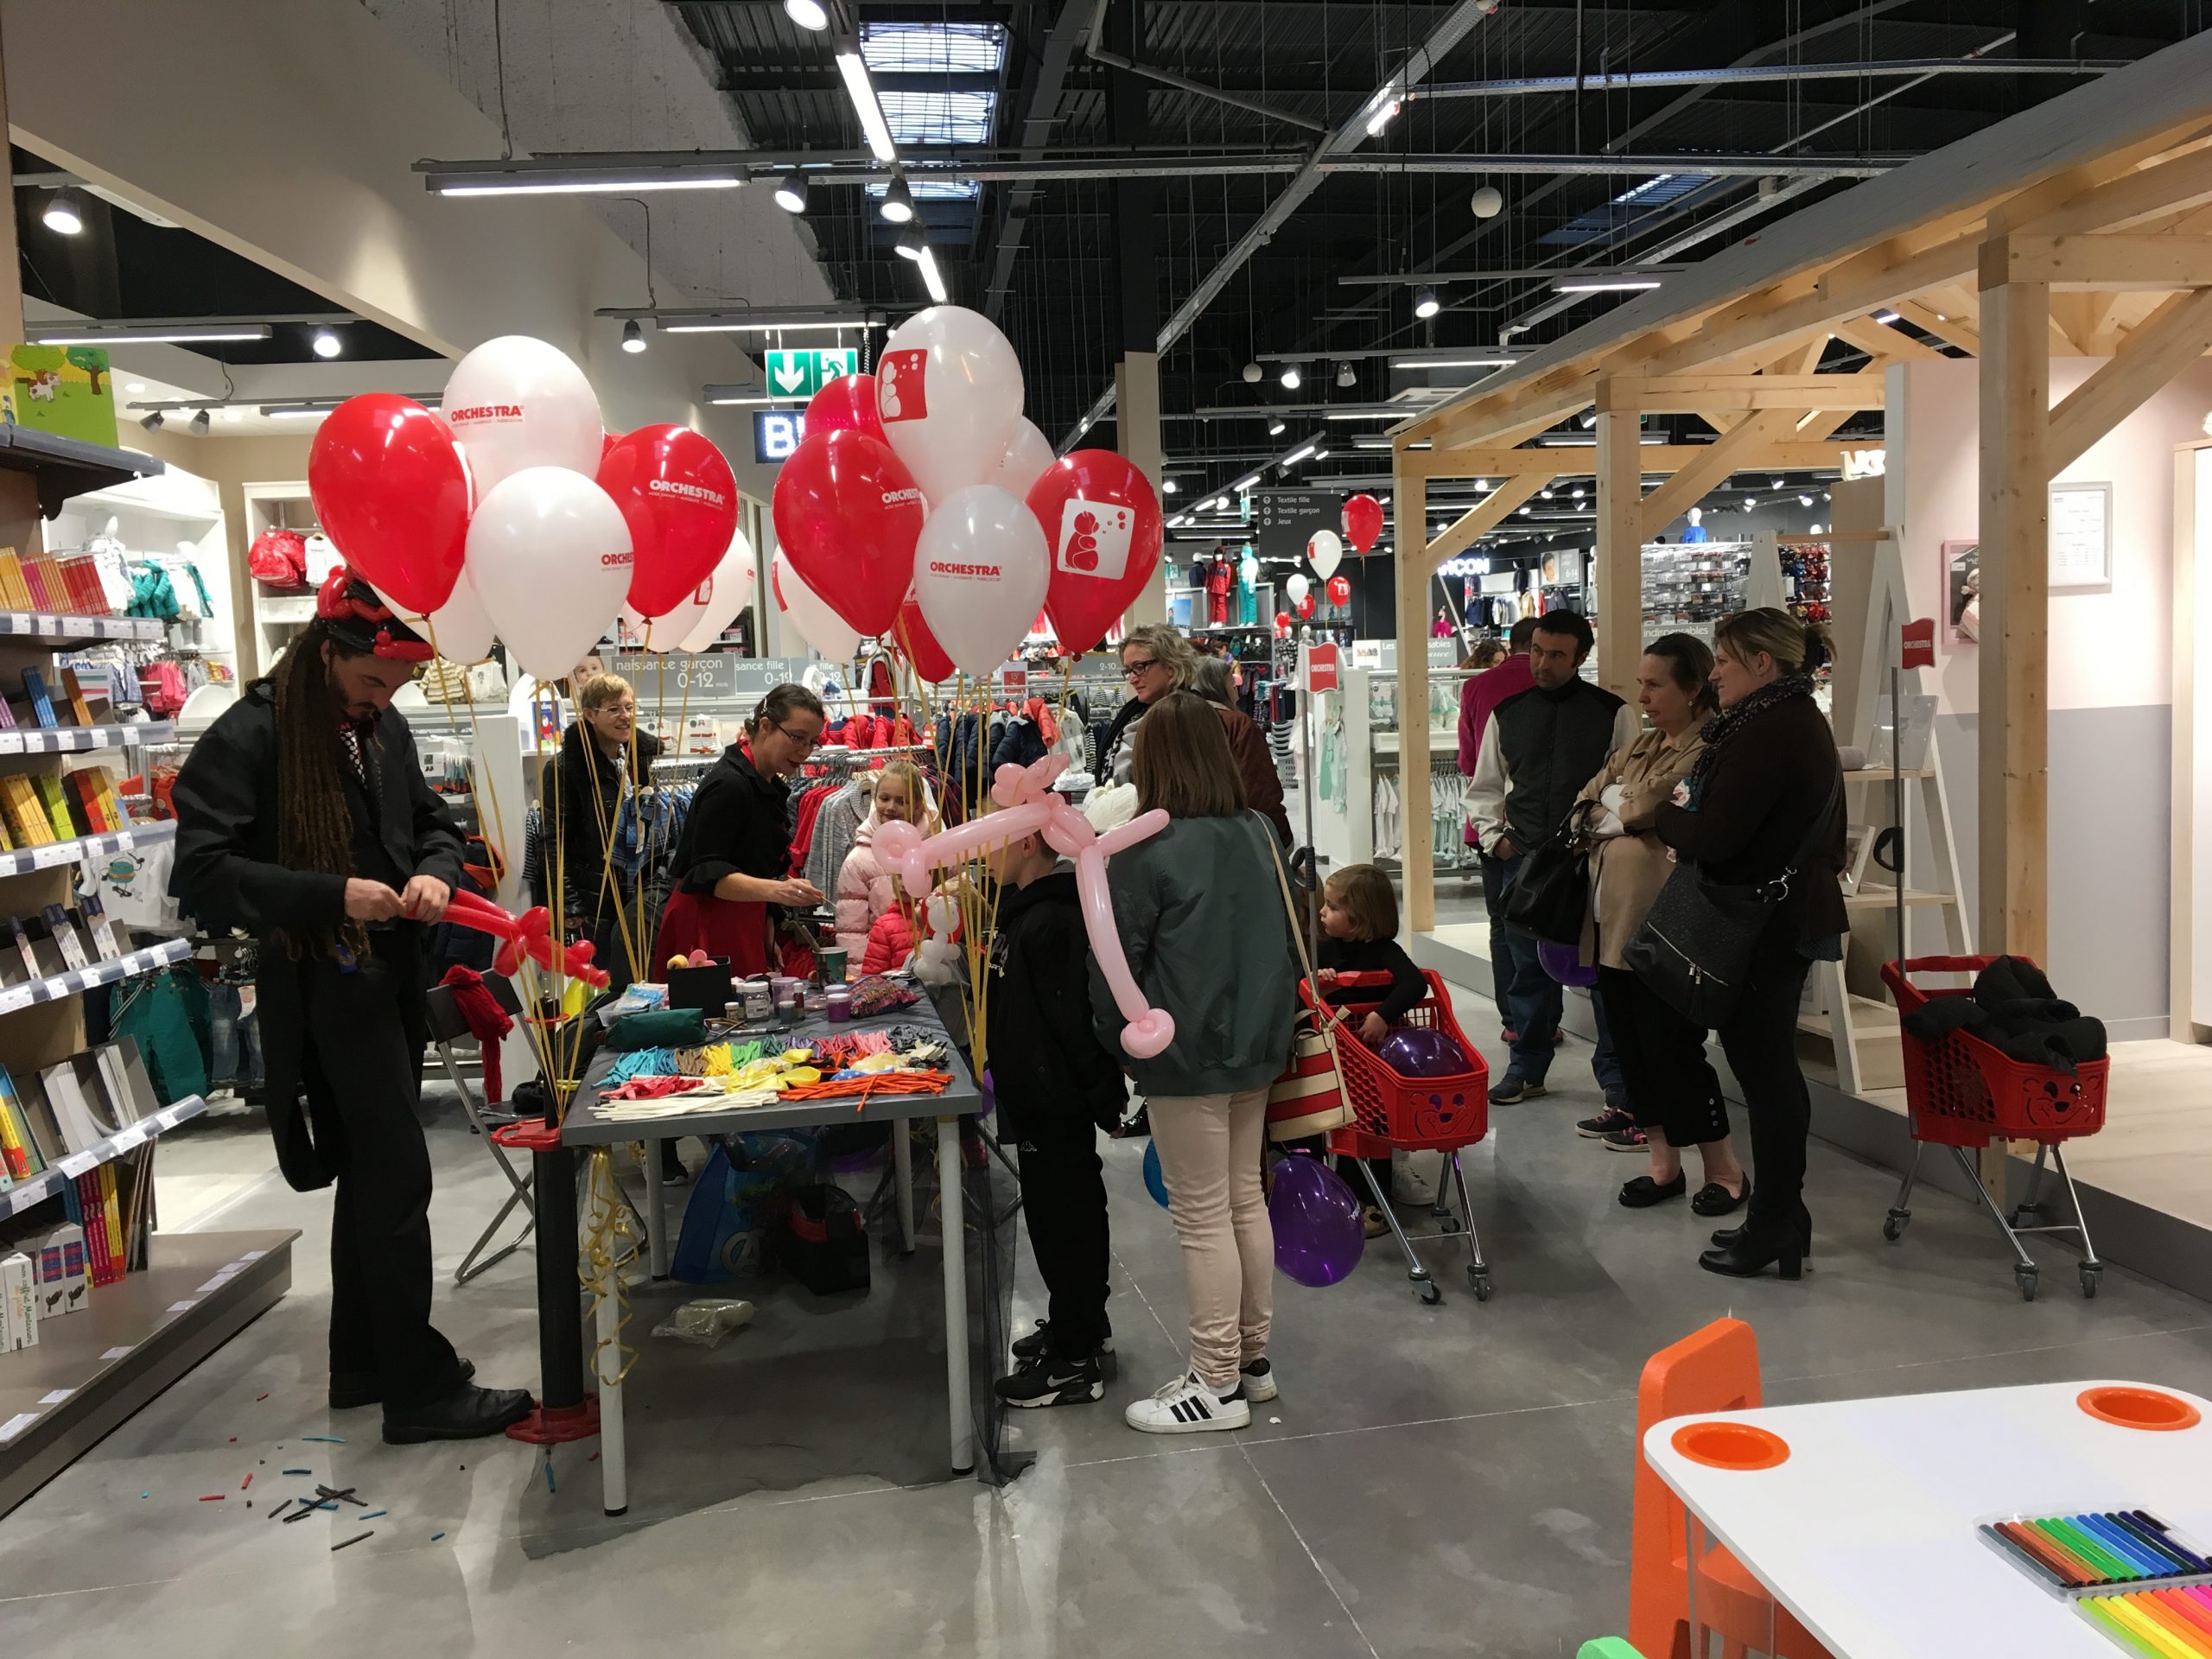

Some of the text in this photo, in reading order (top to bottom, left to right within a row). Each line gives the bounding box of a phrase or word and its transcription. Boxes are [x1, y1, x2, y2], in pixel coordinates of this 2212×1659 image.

[450, 405, 522, 423] ORCHESTRA
[649, 479, 724, 505] ORCHESTRA
[601, 552, 634, 566] ORCHES
[930, 561, 1001, 576] ORCHESTRA
[616, 658, 723, 672] naissance garçon
[766, 660, 785, 671] fille
[677, 672, 714, 689] 0-12
